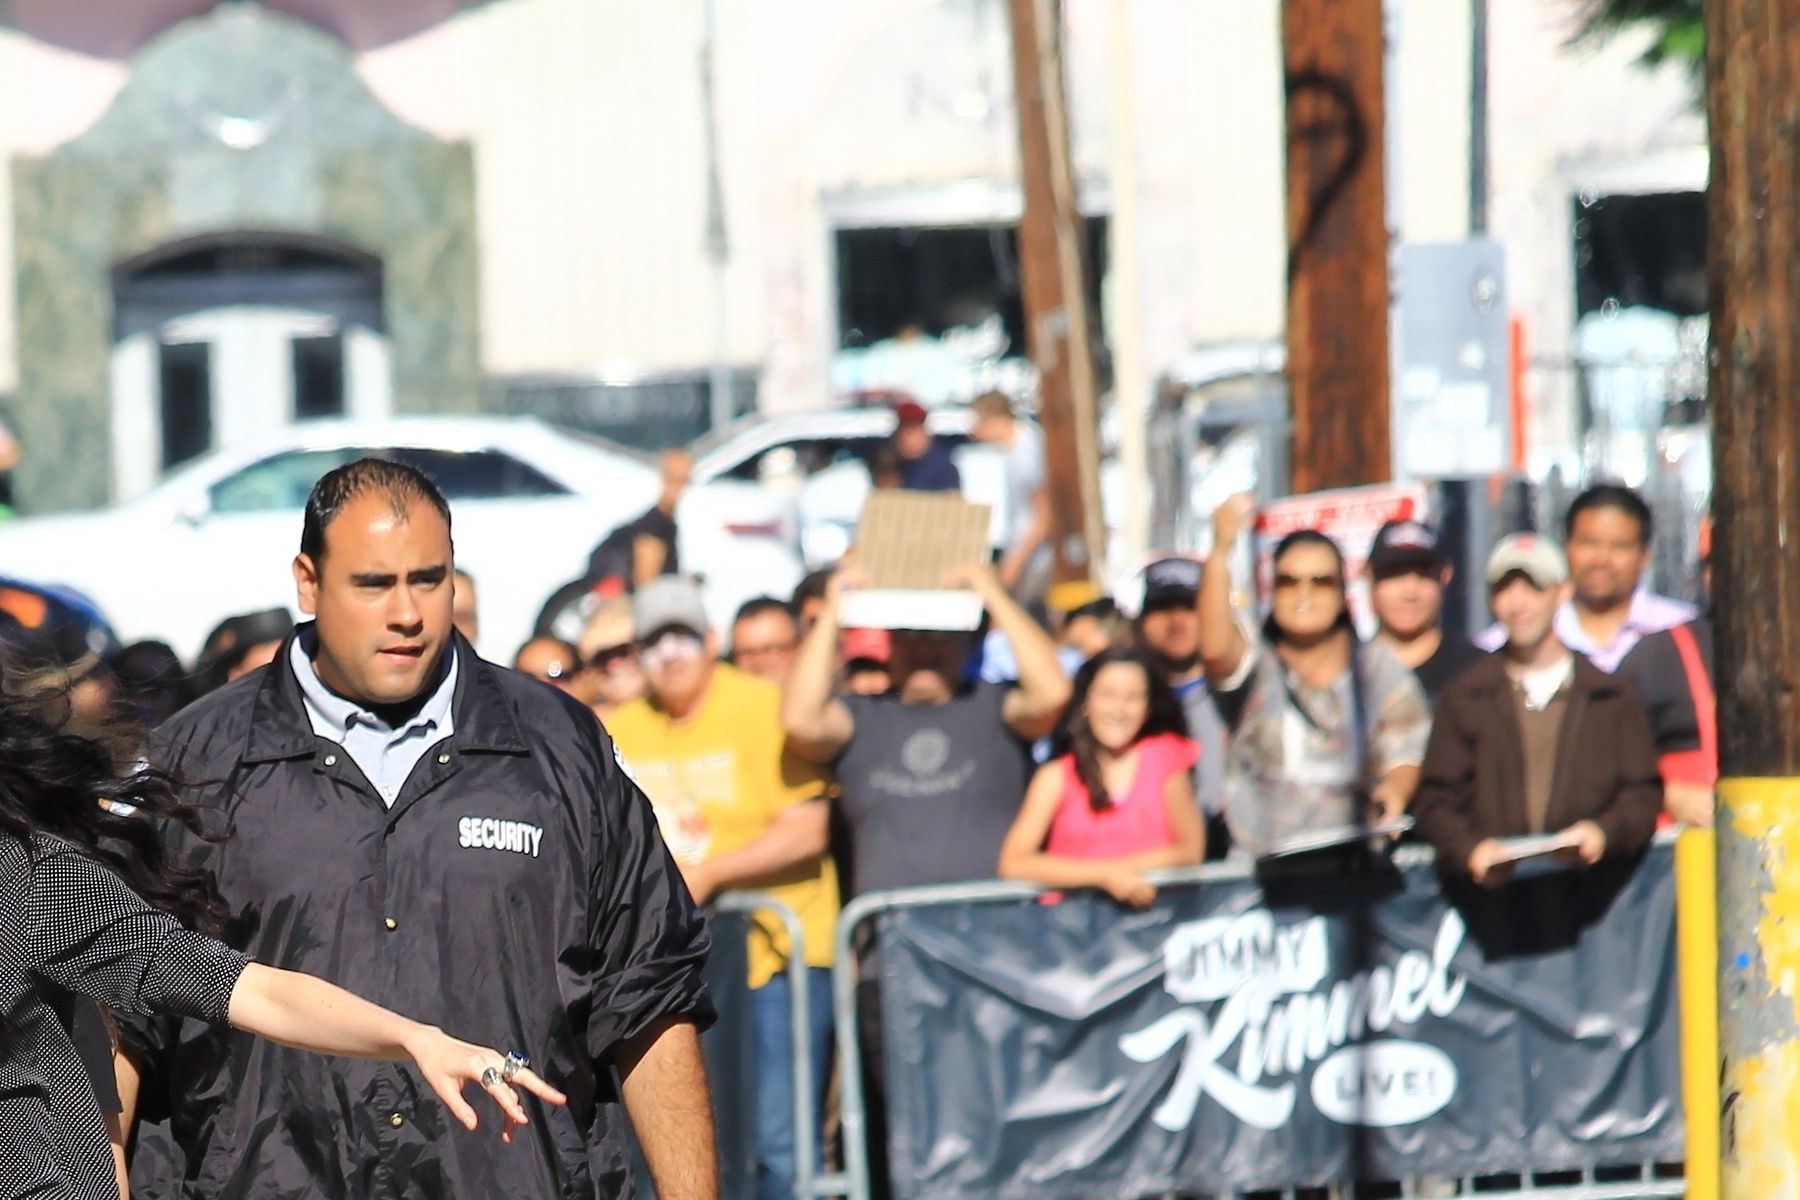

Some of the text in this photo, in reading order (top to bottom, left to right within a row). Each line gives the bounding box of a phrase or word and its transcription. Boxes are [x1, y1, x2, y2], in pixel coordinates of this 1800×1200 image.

[458, 816, 544, 858] SECURITY
[1172, 920, 1308, 983] JIMMY
[1117, 907, 1467, 1132] Kimmel
[1334, 1067, 1437, 1101] LIVE!
